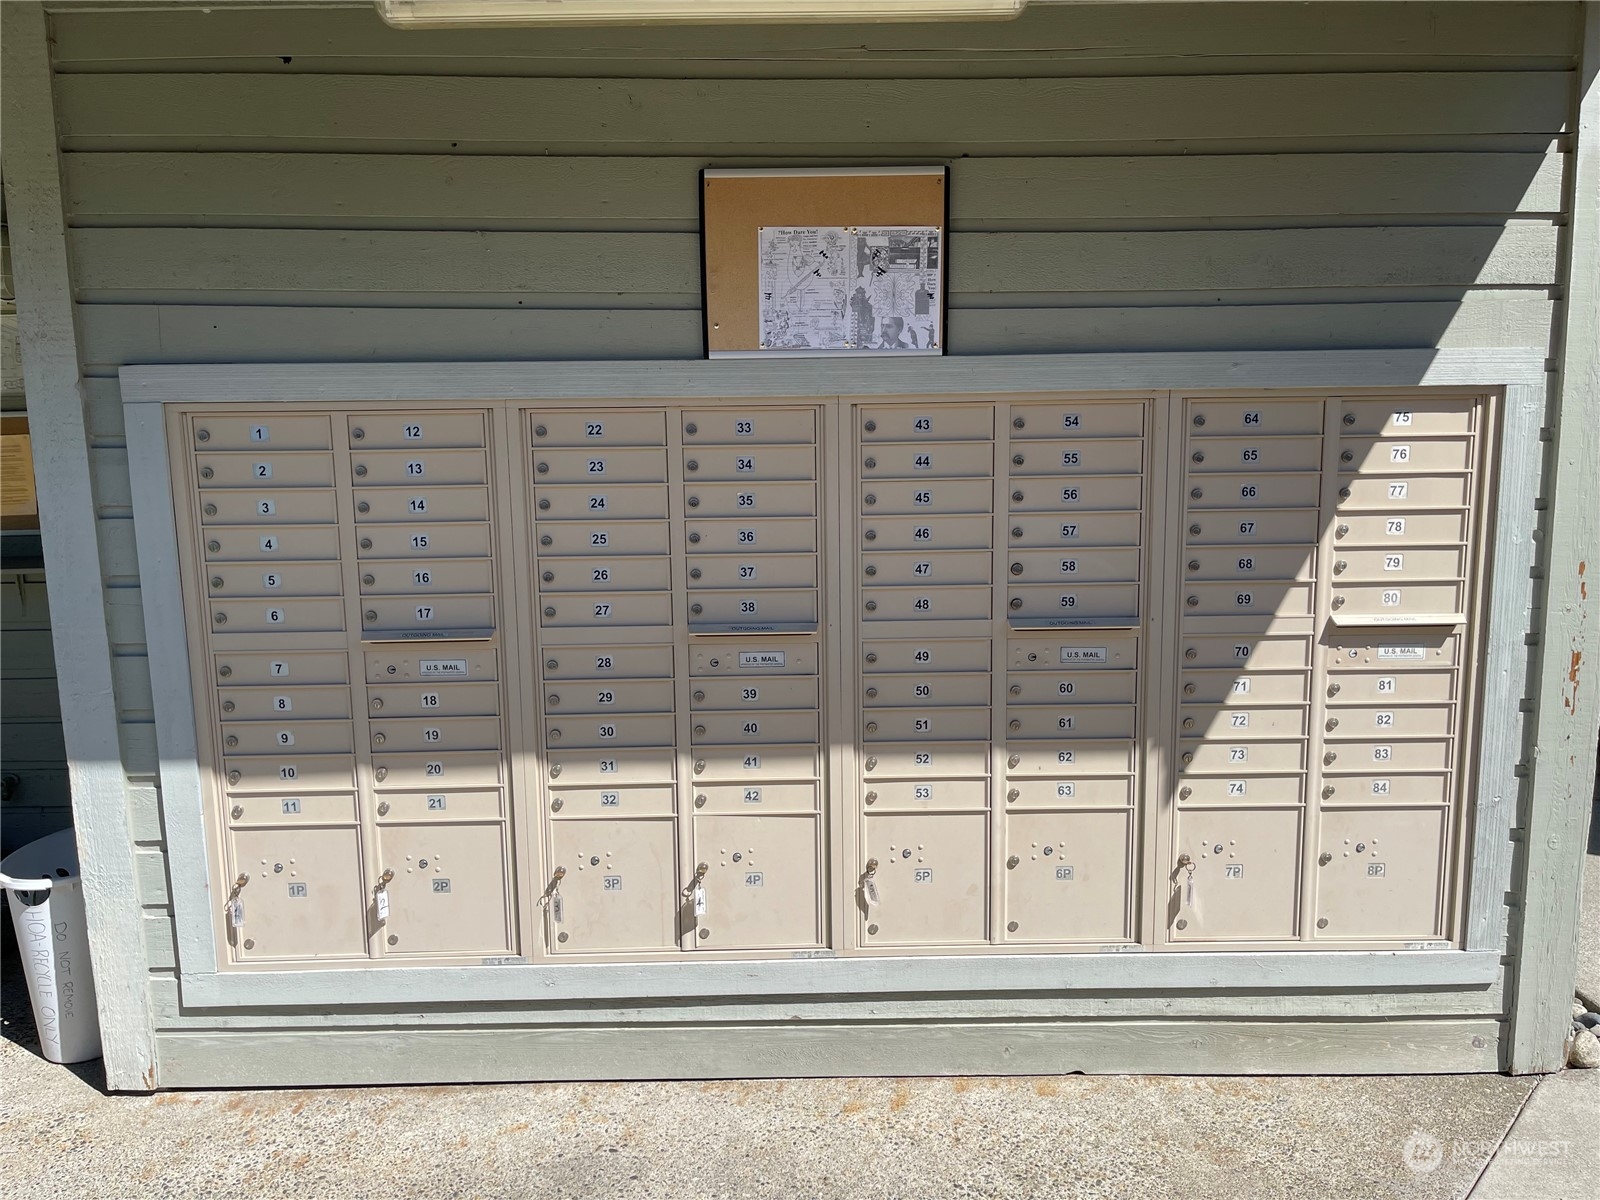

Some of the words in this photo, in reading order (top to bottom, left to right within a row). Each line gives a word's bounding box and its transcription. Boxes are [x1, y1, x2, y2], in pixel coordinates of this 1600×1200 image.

[1064, 415, 1080, 427] 54
[1244, 413, 1259, 424] 64
[1394, 411, 1410, 423] 75
[587, 424, 603, 436] 22
[737, 422, 752, 434] 33
[915, 419, 930, 430] 43
[255, 428, 262, 440] 1
[405, 426, 421, 437] 12
[1063, 452, 1078, 464] 55
[1243, 449, 1258, 461] 65
[1392, 448, 1407, 460] 76
[589, 461, 604, 472] 23
[738, 459, 753, 470] 34
[915, 455, 930, 467] 44
[258, 465, 267, 477] 2
[408, 463, 423, 474] 13
[1063, 489, 1078, 500] 56
[1241, 486, 1256, 497] 66
[1390, 485, 1405, 496] 77
[590, 497, 605, 509] 24
[738, 495, 753, 506] 35
[915, 492, 930, 503] 45
[262, 502, 270, 514] 3
[410, 500, 425, 511] 14
[1062, 525, 1077, 536] 57
[1240, 522, 1255, 534] 67
[1388, 521, 1402, 532] 78
[592, 533, 607, 545] 25
[739, 531, 754, 542] 36
[914, 528, 930, 539] 46
[264, 539, 273, 550] 4
[412, 536, 427, 547] 15
[1061, 560, 1076, 572] 58
[1238, 558, 1253, 569] 68
[1386, 557, 1401, 568] 79
[740, 566, 755, 578] 37
[914, 563, 930, 574] 47
[268, 575, 276, 586] 5
[415, 572, 430, 583] 16
[593, 569, 608, 581] 26
[1060, 596, 1075, 607] 59
[1236, 593, 1251, 605] 69
[1383, 592, 1398, 604] 80
[741, 601, 755, 613] 38
[914, 599, 929, 610] 48
[271, 610, 279, 621] 6
[417, 608, 431, 619] 17
[595, 605, 610, 616] 27
[914, 651, 929, 662] 49
[1235, 646, 1249, 657] 70
[597, 657, 612, 668] 28
[275, 663, 282, 674] 7
[915, 685, 930, 696] 50
[1059, 683, 1073, 694] 60
[1232, 681, 1247, 692] 71
[1378, 680, 1392, 691] 81
[598, 692, 613, 703] 29
[743, 688, 757, 699] 39
[278, 698, 286, 709] 8
[423, 695, 437, 706] 18
[915, 719, 928, 730] 51
[1058, 717, 1072, 728] 61
[1232, 715, 1246, 726] 72
[1376, 714, 1391, 725] 82
[600, 726, 614, 737] 30
[743, 722, 758, 734] 40
[281, 733, 289, 744] 9
[425, 730, 439, 741] 19
[915, 753, 930, 764] 52
[1057, 751, 1073, 762] 62
[1230, 749, 1245, 760] 73
[1374, 748, 1389, 759] 83
[600, 760, 614, 771] 31
[743, 756, 757, 767] 41
[281, 767, 295, 778] 10
[426, 764, 441, 775] 20
[915, 787, 930, 799] 53
[1057, 785, 1072, 796] 63
[1229, 783, 1244, 794] 74
[1372, 782, 1387, 793] 84
[602, 794, 617, 805] 32
[744, 790, 759, 801] 42
[283, 801, 297, 812] 11
[428, 798, 442, 809] 21
[1055, 868, 1072, 879] 6P
[1225, 866, 1242, 877] 7P
[1367, 865, 1383, 876] 8P
[745, 874, 762, 885] 4P
[914, 871, 931, 882] 5P
[432, 881, 449, 892] 2P
[604, 878, 620, 889] 3P
[289, 885, 306, 896] 1P
[54, 922, 67, 942] DO
[59, 951, 71, 976] NOT
[62, 981, 74, 1018] REMOVE
[41, 1006, 60, 1045] ONLY
